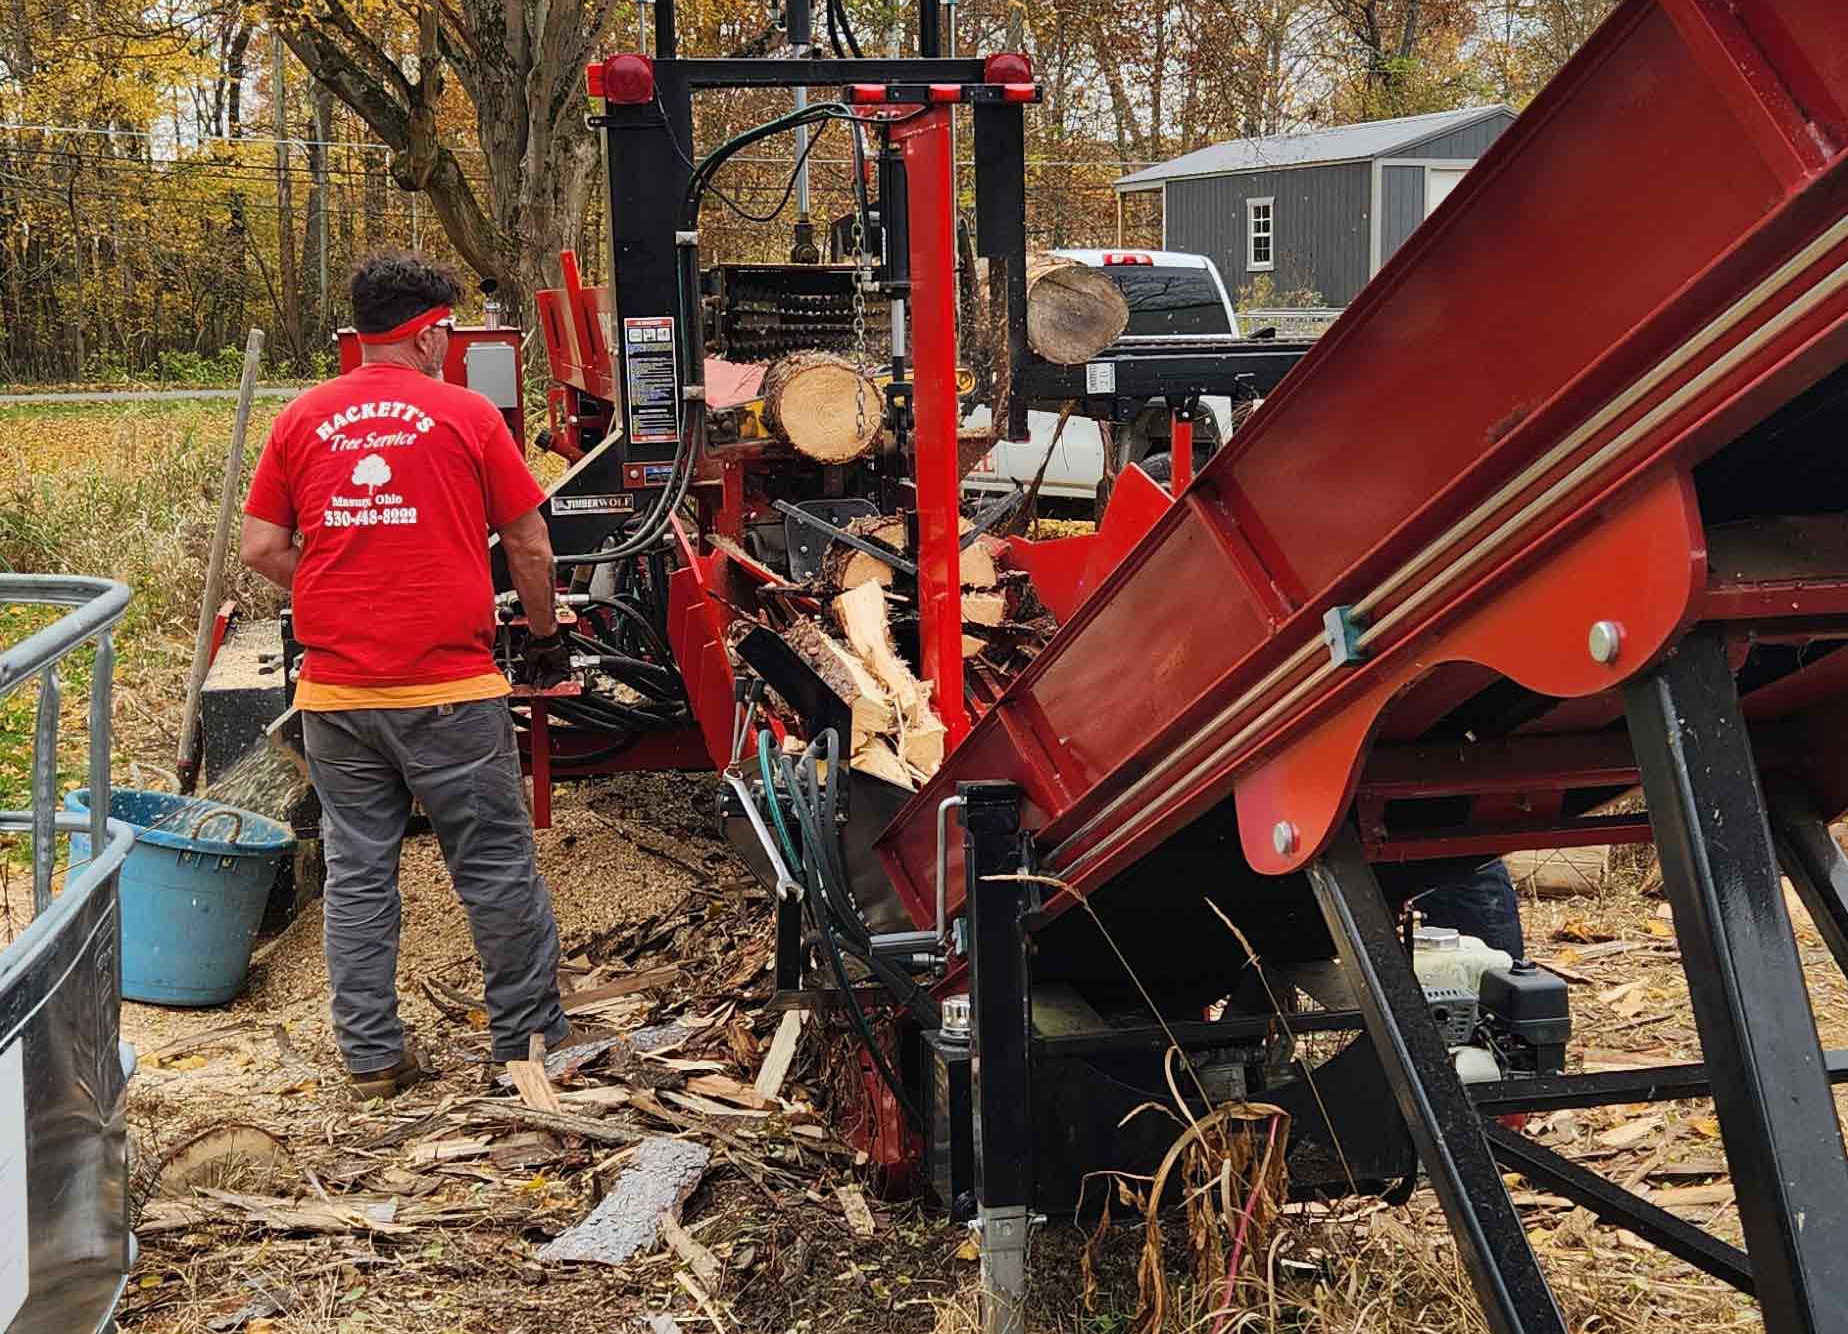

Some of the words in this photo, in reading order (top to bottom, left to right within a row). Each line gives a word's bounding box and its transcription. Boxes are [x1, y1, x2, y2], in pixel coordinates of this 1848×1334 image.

[316, 401, 436, 442] HACKETT'S
[330, 434, 362, 451] Tree
[364, 431, 417, 448] Service
[375, 494, 403, 504] Ohio
